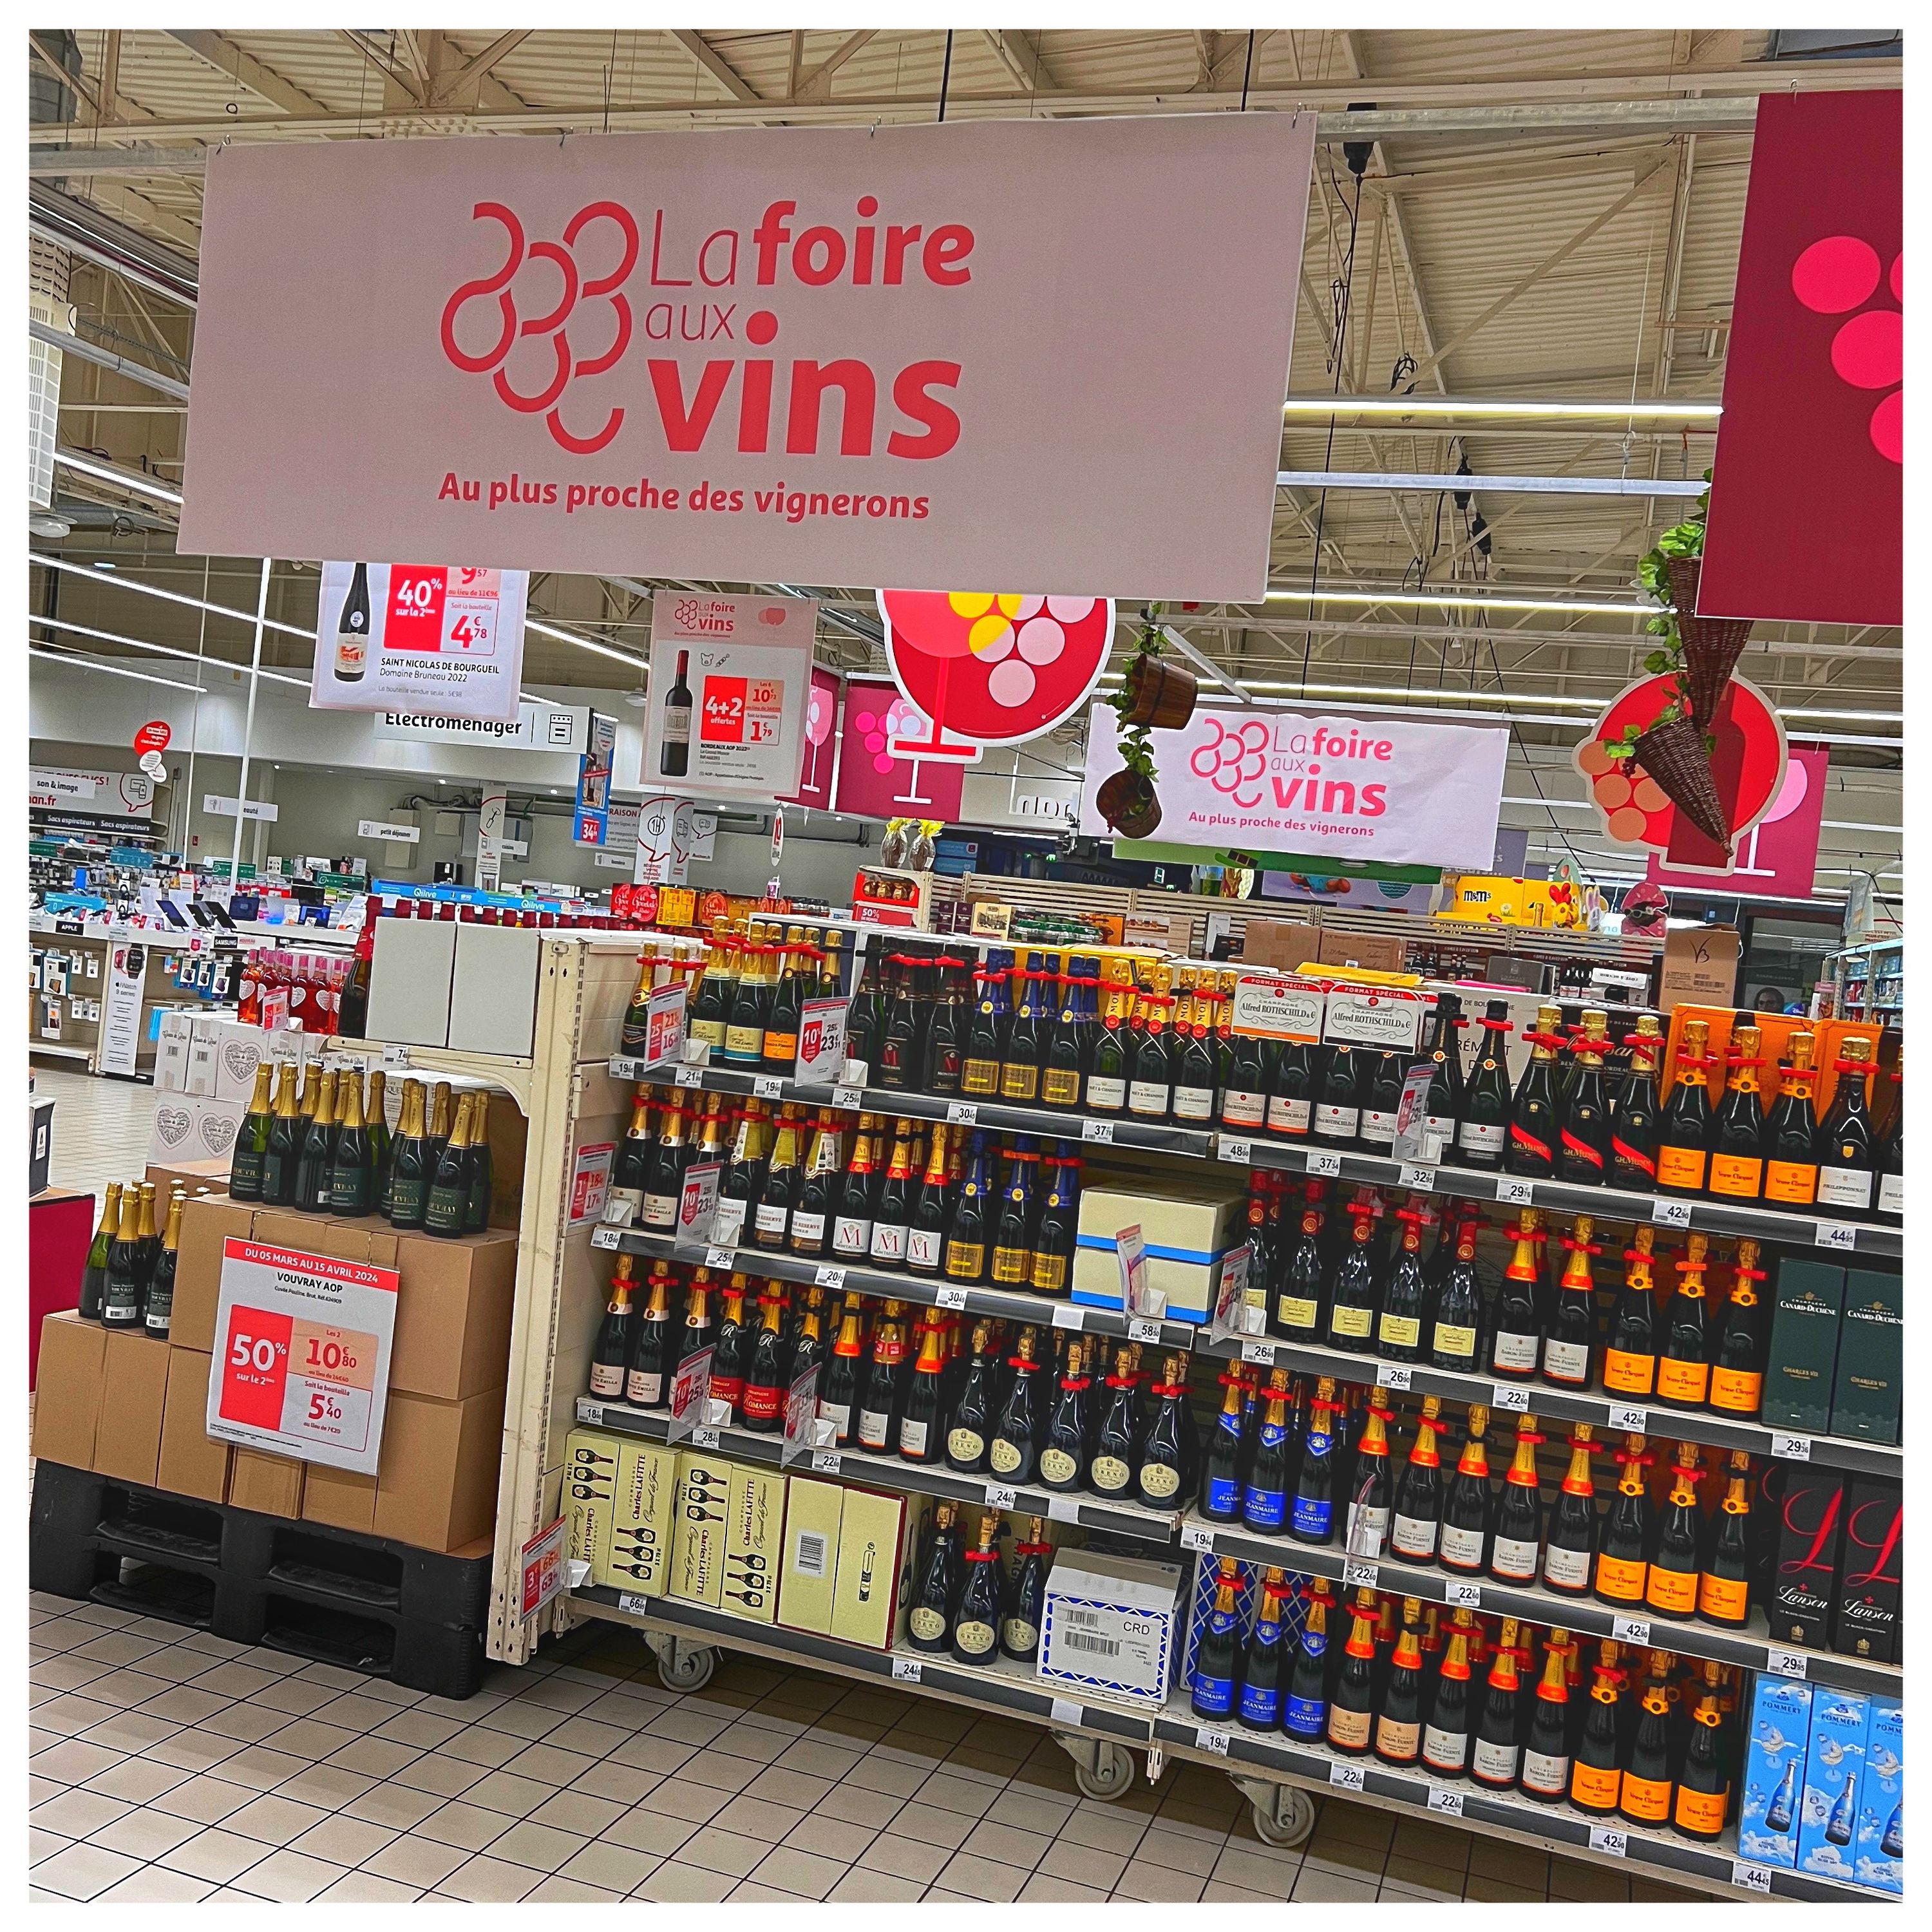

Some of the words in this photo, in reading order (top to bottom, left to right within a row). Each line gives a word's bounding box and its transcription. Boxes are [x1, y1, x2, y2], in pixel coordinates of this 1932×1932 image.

[650, 209, 738, 287] La
[753, 195, 975, 286] foire
[646, 302, 735, 341] aux
[648, 310, 962, 459] vins
[438, 472, 480, 502] Au
[489, 473, 557, 510] plus
[567, 478, 679, 513] proche
[688, 481, 743, 512] des
[754, 482, 929, 523] vignerons
[710, 601, 735, 612] foire
[699, 614, 734, 631] vins
[381, 658, 404, 667] SAINT
[406, 659, 440, 669] NICOLAS
[454, 662, 499, 674] BOURGUEIL
[380, 668, 412, 678] Domaine
[414, 670, 446, 681] Bruneau
[448, 673, 467, 682] 2022
[710, 717, 735, 725] offertes
[1273, 726, 1306, 754] La
[1312, 728, 1392, 760] foire
[1271, 757, 1304, 772] aux
[57, 782, 79, 792] image
[1272, 764, 1387, 816] vins
[609, 808, 637, 817] RAISON
[62, 817, 95, 826] aspirateurs
[115, 822, 149, 831] aspirateurs
[1189, 811, 1205, 822] Au
[1209, 813, 1236, 826] plus
[1240, 817, 1280, 829] proche
[1285, 818, 1305, 830] des
[1310, 820, 1374, 836] vignerons
[1281, 981, 1309, 990] SPÉCIAL
[1376, 990, 1405, 998] SPÉCIAL
[1240, 1003, 1261, 1012] Alfred
[1262, 1005, 1305, 1018] ROTHSCHILD
[1332, 1012, 1353, 1022] Alfred
[1354, 1014, 1399, 1027] ROTHSCHILD
[245, 1248, 258, 1259] DU
[260, 1250, 271, 1261] 05
[273, 1253, 298, 1266] MARS
[299, 1258, 313, 1269] AU
[314, 1262, 325, 1272] 15
[327, 1264, 353, 1278] AVRIL
[355, 1270, 377, 1283] 2024
[277, 1272, 321, 1289] VOUVRAY
[323, 1282, 343, 1293] AOP
[236, 1374, 250, 1382] sur
[743, 1516, 752, 1546] Charles
[700, 1530, 708, 1558] Charles
[1123, 1622, 1150, 1635] CRD
[1762, 1700, 1801, 1714] POMMERY
[1822, 1714, 1861, 1727] POMMERY
